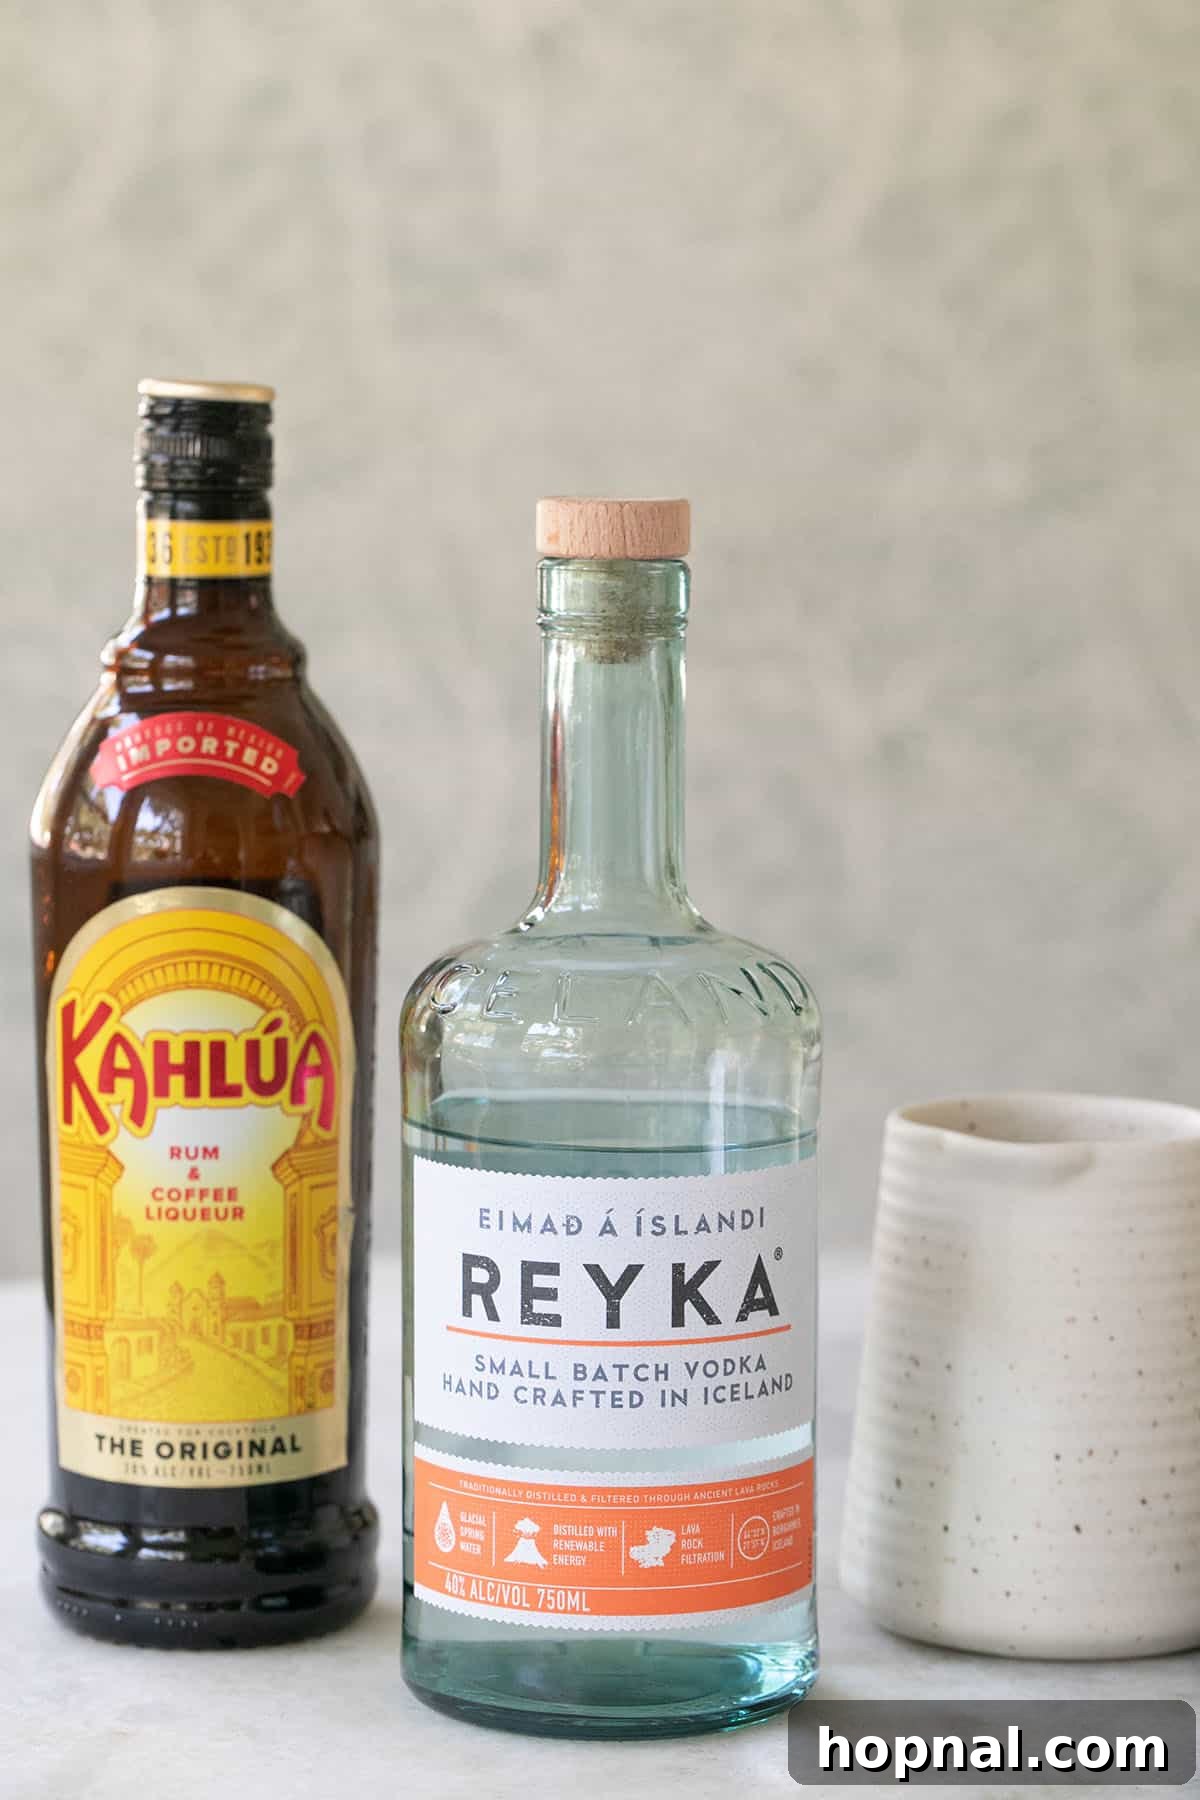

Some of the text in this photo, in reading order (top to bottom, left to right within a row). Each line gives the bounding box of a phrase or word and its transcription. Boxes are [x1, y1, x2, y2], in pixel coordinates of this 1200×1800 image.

[115, 735, 279, 776] IMPORTED
[61, 999, 335, 1137] KAHLÚA
[170, 1146, 220, 1160] RUM
[188, 1167, 200, 1181] &
[151, 1187, 239, 1203] COFFEE
[146, 1206, 246, 1222] LIQUEUR
[479, 1206, 766, 1238] EIMAÐ Á ÍSLANDI
[474, 1353, 768, 1383] SMALL BATCH VODKA
[443, 1372, 794, 1409] HAND CRAFTED IN ICELAND
[95, 1432, 303, 1461] THE ORIGINAL
[458, 1479, 523, 1499] TRADITIONALLY
[526, 1491, 577, 1504] DISTILLED
[581, 1495, 588, 1504] &
[591, 1494, 640, 1504] FILTERED
[644, 1493, 691, 1503] THROUGH
[693, 1488, 733, 1501] ANCIENT
[734, 1485, 755, 1497] LAVA
[459, 1510, 487, 1528] GLACIAL
[459, 1526, 485, 1542] SPRING
[553, 1523, 618, 1538] DISTILLED WITH
[681, 1524, 701, 1536] LAVA
[459, 1540, 481, 1556] WATER
[553, 1540, 605, 1553] RENEWABLE
[681, 1538, 704, 1551] ROCK
[553, 1554, 587, 1567] ENERGY
[681, 1551, 725, 1566] FILTRATION
[444, 1571, 591, 1612] 40% ALC/VOL 750ML
